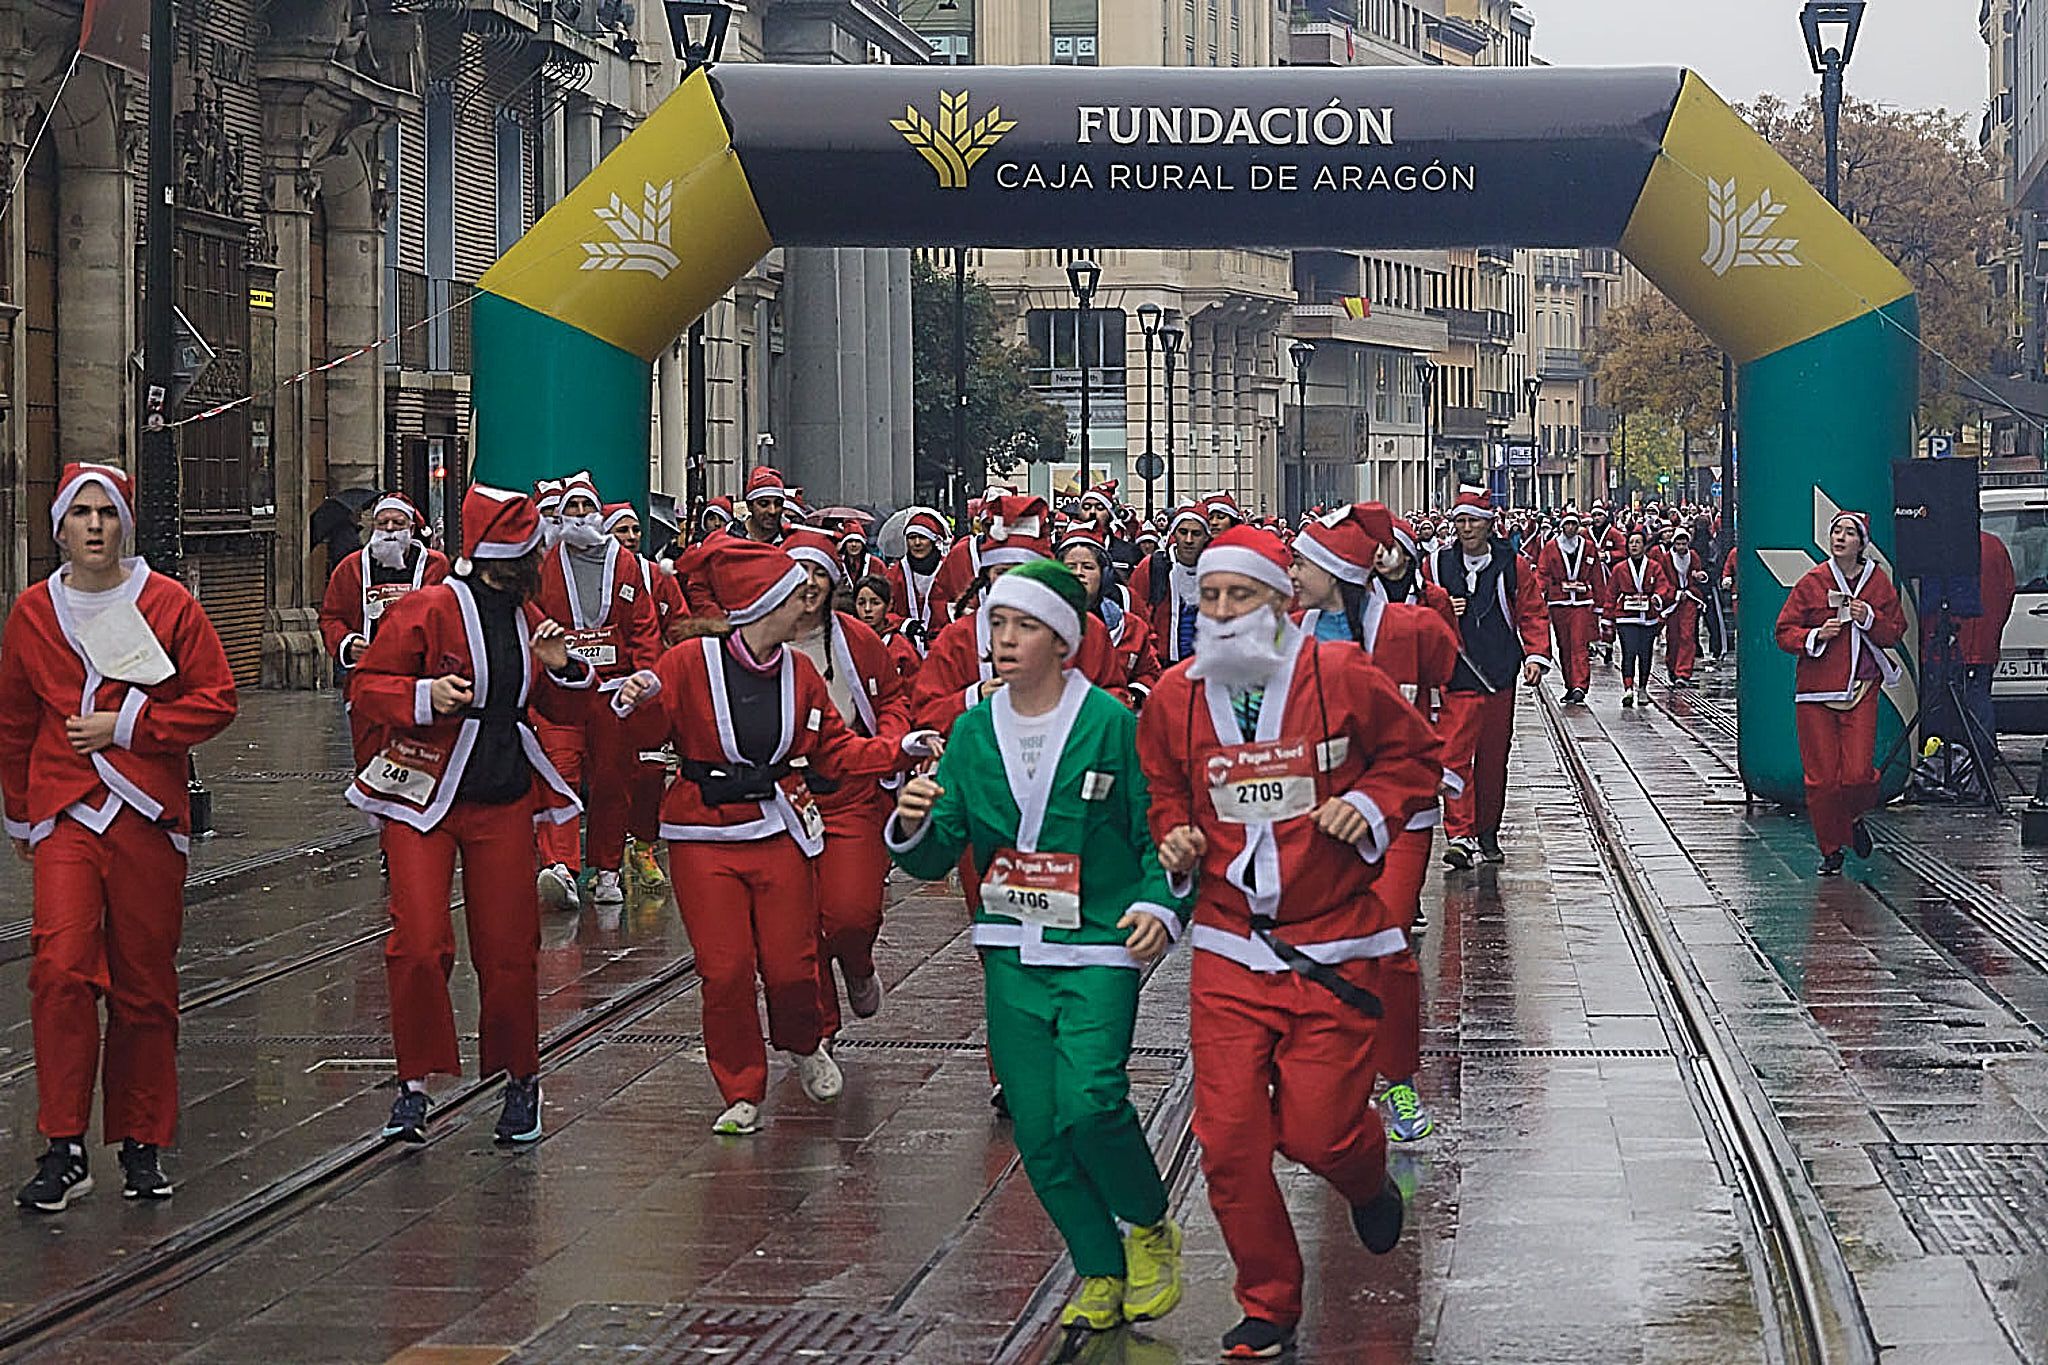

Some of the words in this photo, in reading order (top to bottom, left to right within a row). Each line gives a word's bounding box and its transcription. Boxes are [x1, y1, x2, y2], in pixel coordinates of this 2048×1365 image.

[1077, 97, 1394, 145] FUNDACIÓN
[996, 163, 1094, 191] CAJA
[1110, 163, 1234, 191] RURAL
[1251, 164, 1297, 191] DE
[1313, 159, 1475, 192] ARAGÓN
[1932, 438, 1948, 458] P
[381, 763, 410, 783] 248
[1236, 781, 1284, 804] 2709
[1007, 889, 1050, 910] 2706
